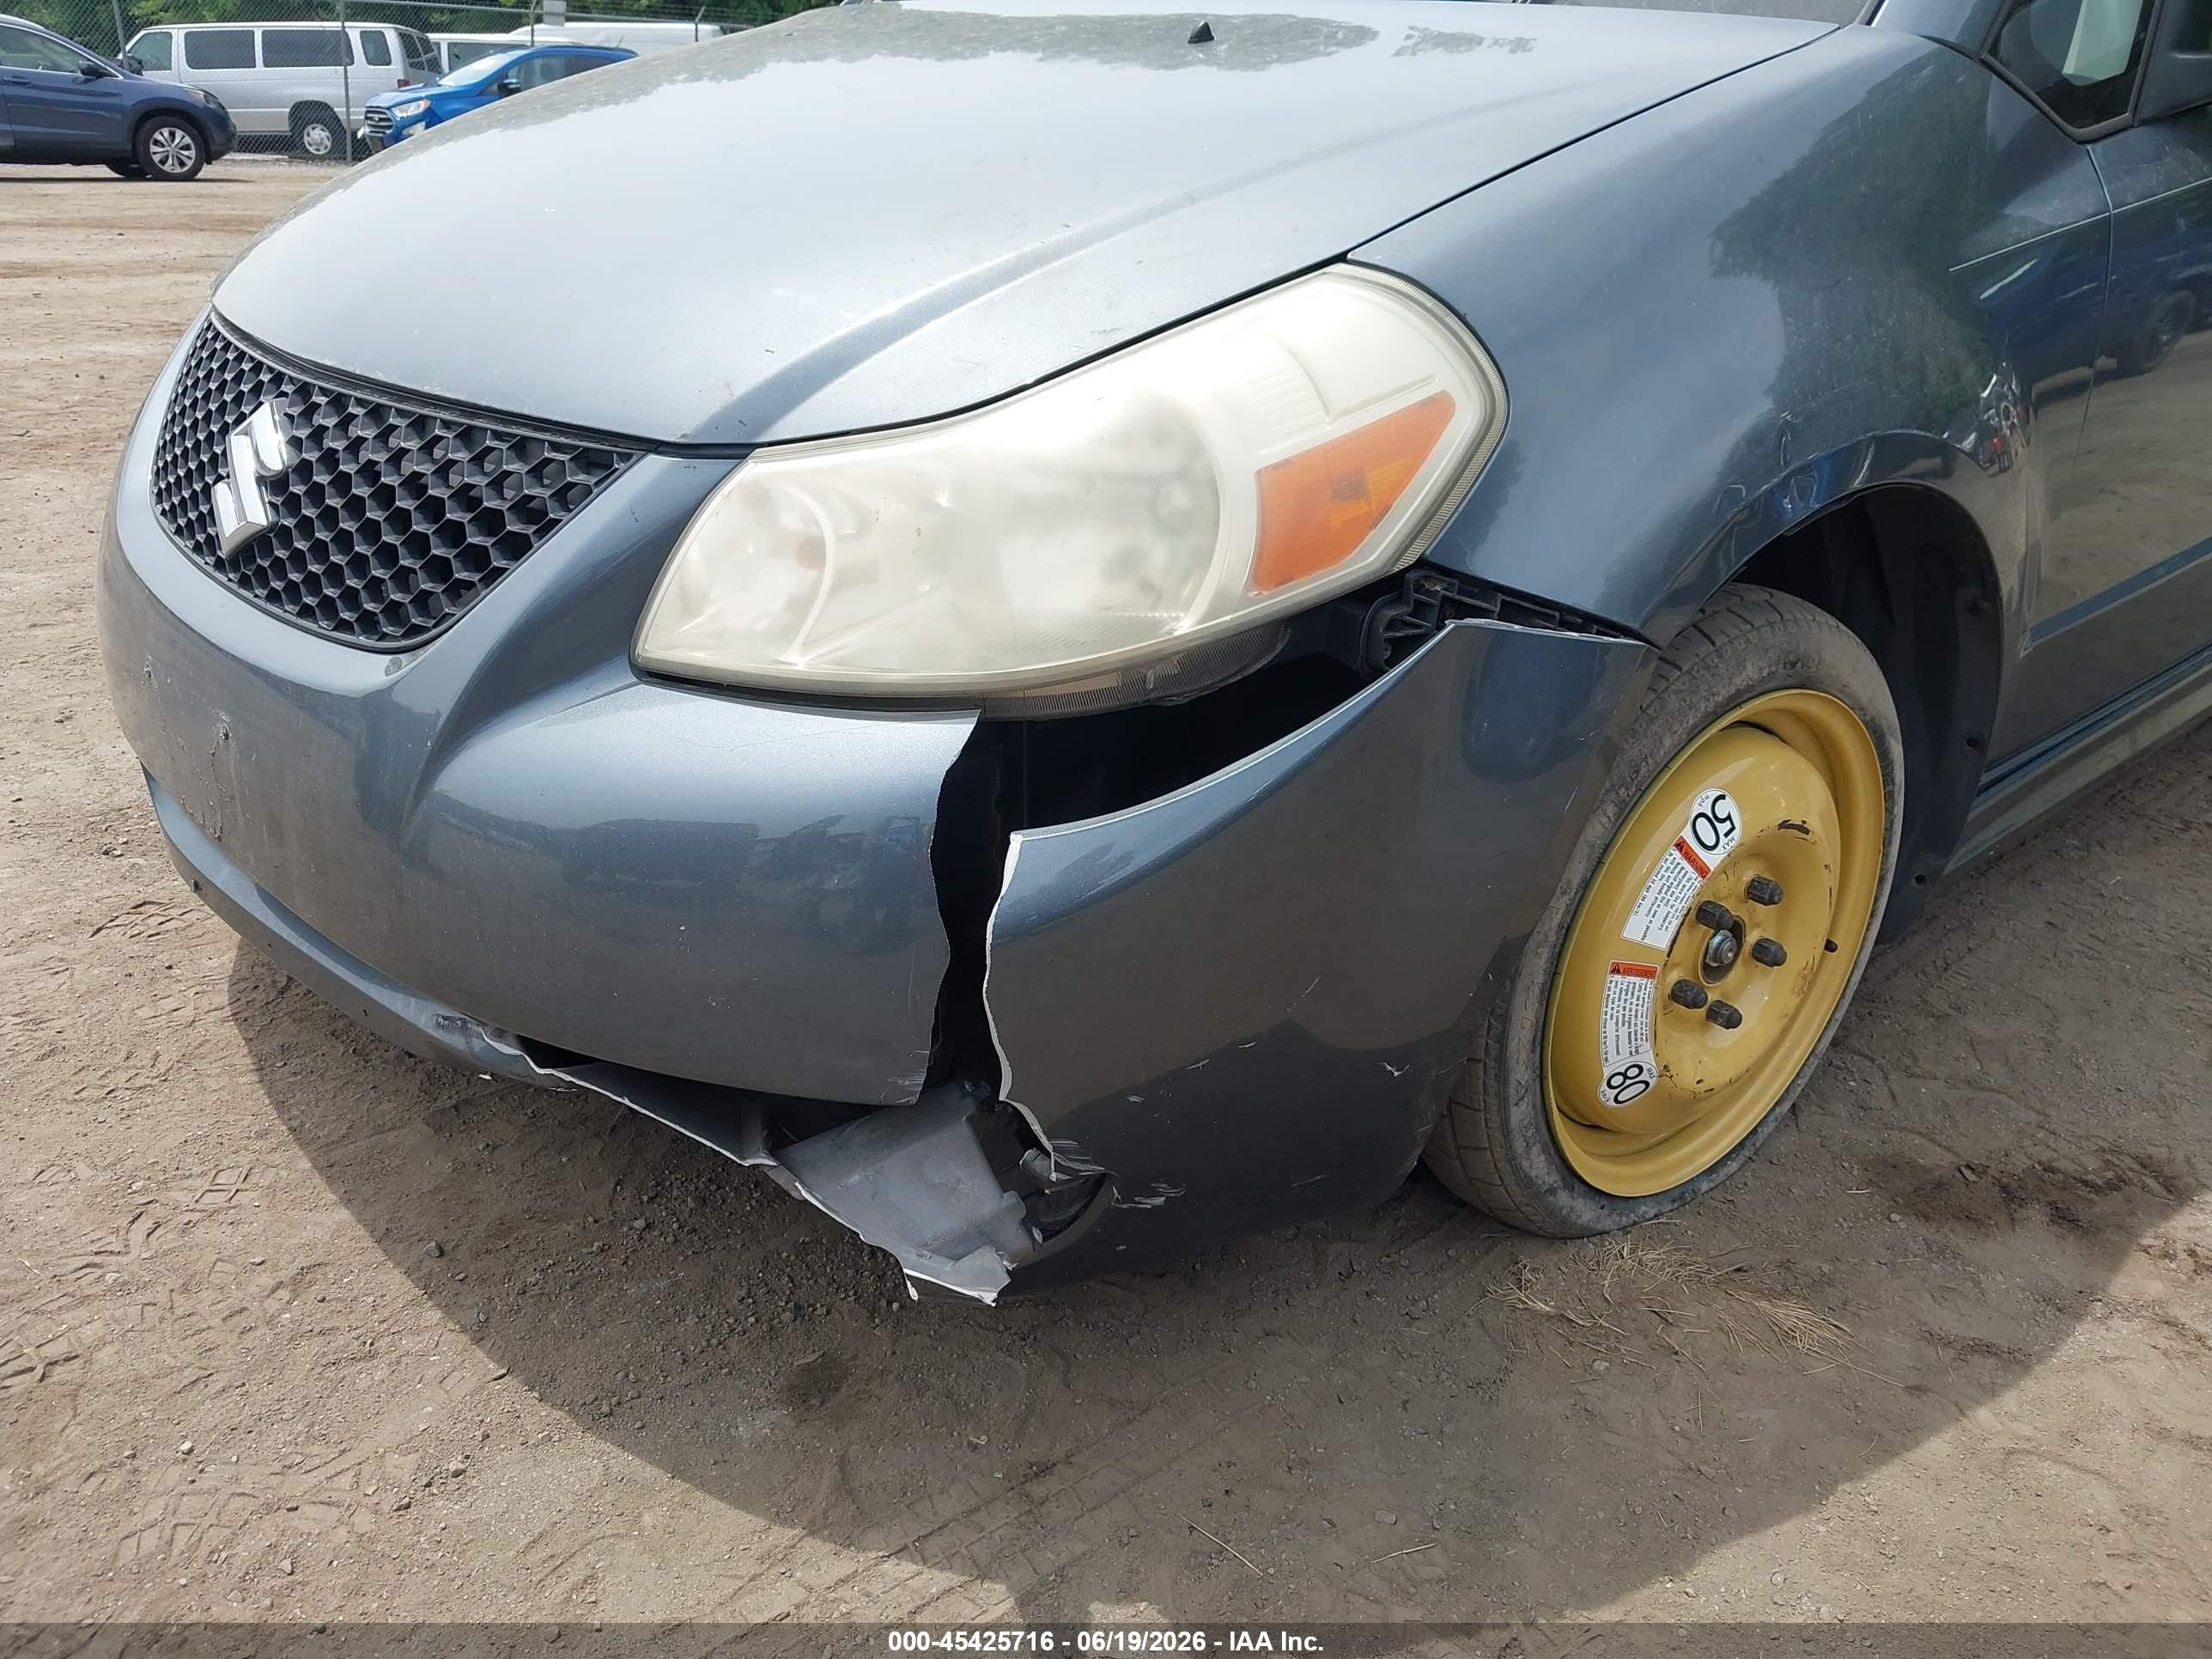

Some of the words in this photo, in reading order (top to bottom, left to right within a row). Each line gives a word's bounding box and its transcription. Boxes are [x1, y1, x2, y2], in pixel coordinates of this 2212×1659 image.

[1691, 793, 1736, 852] 50
[1723, 836, 1735, 852] MAX
[1682, 850, 1708, 878] WARNING
[1607, 1063, 1650, 1104] 80
[1646, 1067, 1656, 1079] MAX
